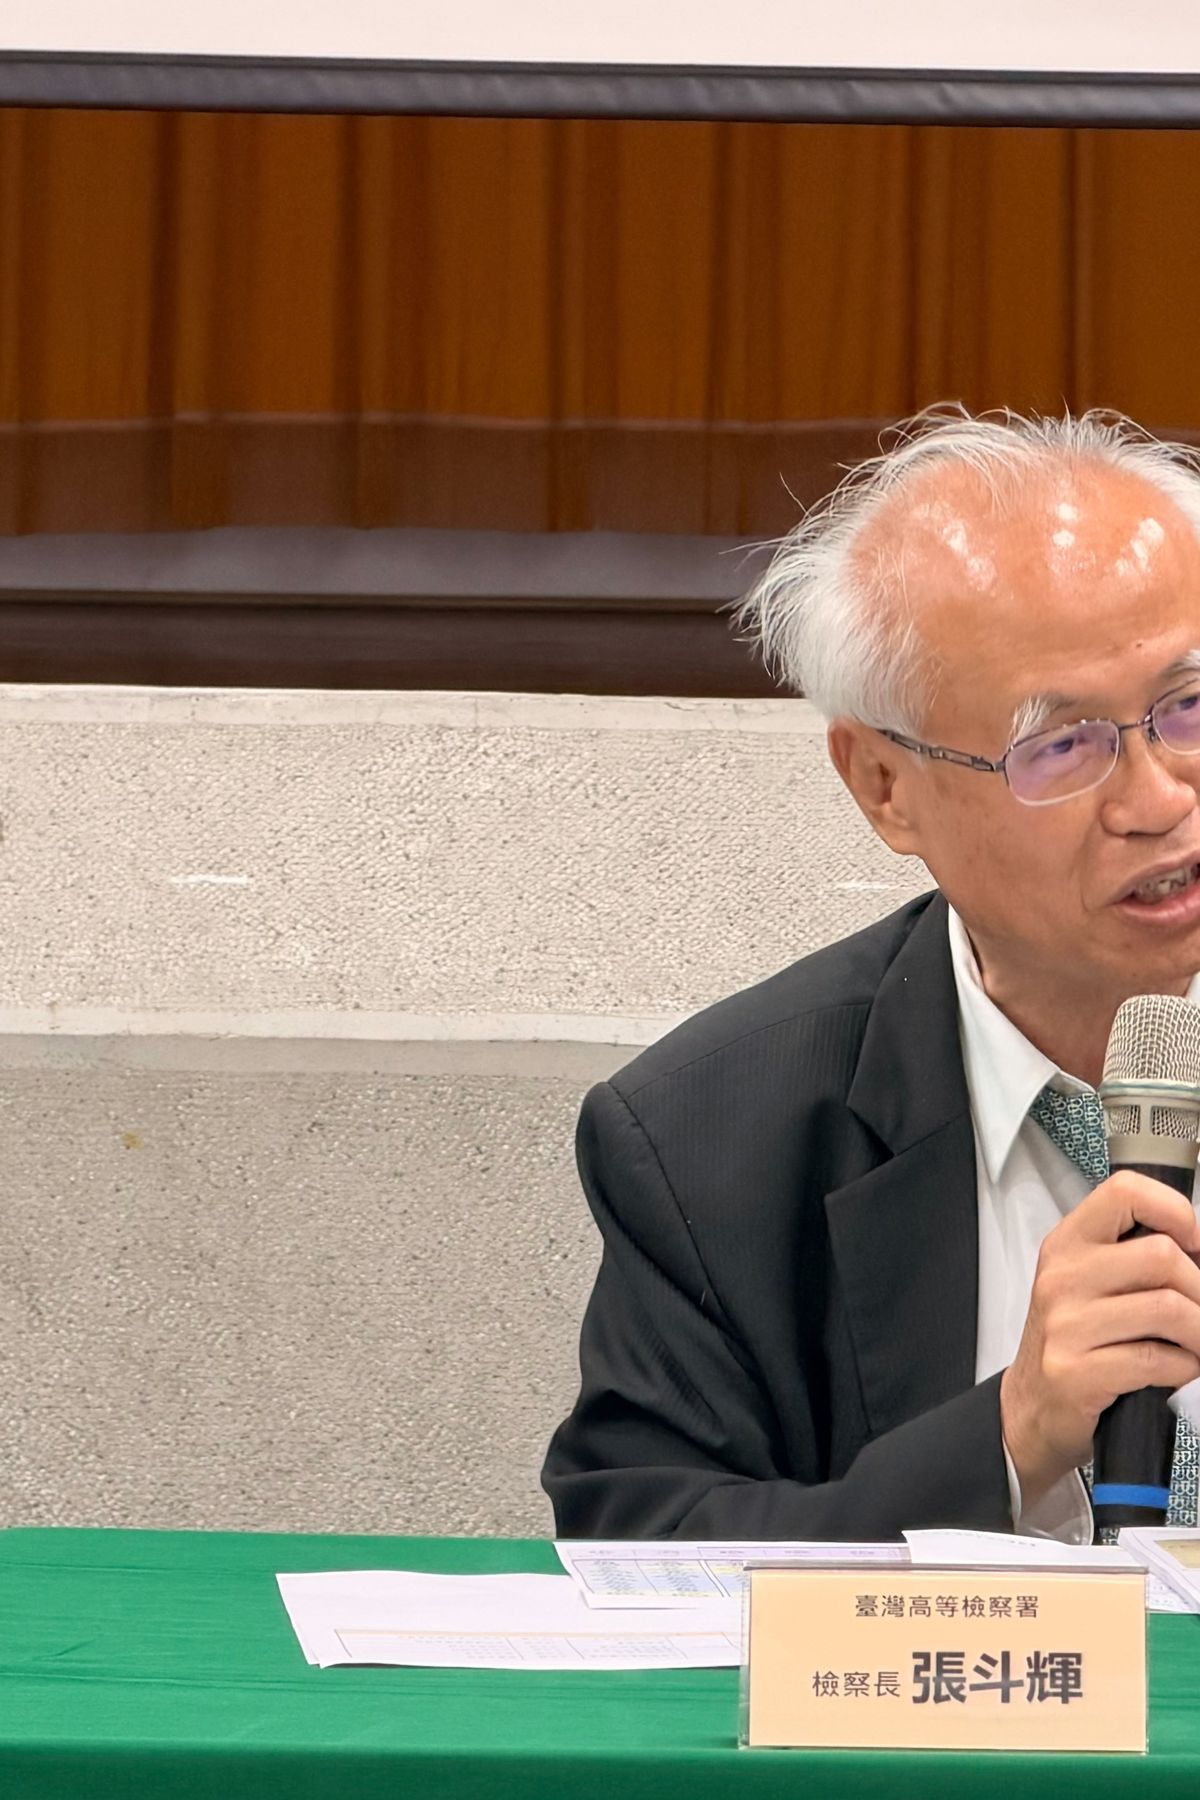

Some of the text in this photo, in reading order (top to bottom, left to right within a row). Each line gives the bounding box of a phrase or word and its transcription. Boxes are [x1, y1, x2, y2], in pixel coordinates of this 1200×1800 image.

[854, 1594, 1040, 1619] 臺灣高等檢察署
[811, 1650, 1084, 1705] 檢察長 張斗輝
